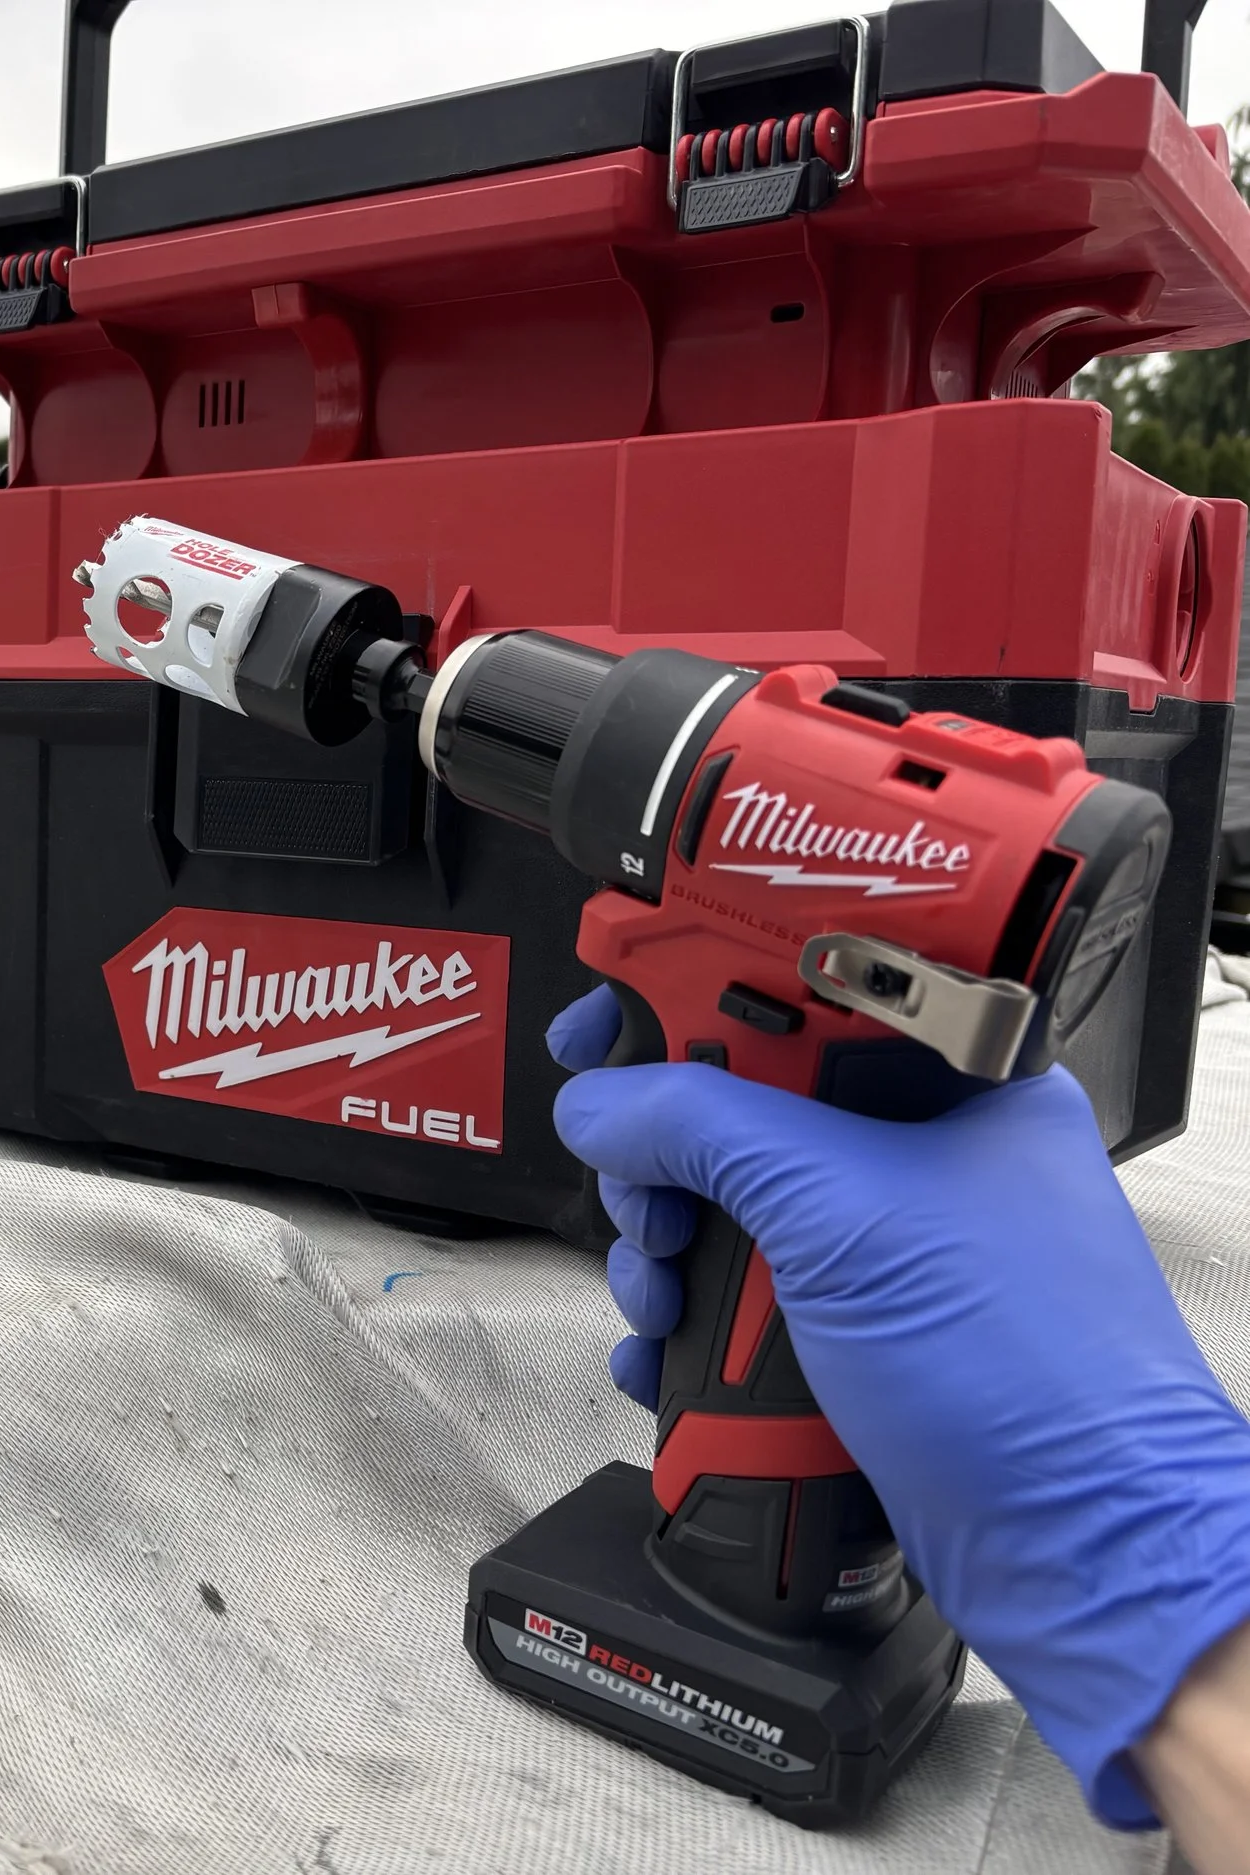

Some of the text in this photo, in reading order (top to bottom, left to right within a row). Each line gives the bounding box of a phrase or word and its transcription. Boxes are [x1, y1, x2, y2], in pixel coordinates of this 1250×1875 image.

[170, 543, 257, 575] DOZER
[184, 538, 235, 557] HOLE
[719, 781, 971, 872] Milwaukee
[620, 852, 644, 877] 12
[670, 883, 808, 947] BRUSHLESS
[132, 938, 477, 1049] Milwaukee
[341, 1095, 500, 1148] FUEL
[515, 1634, 790, 1769] HIGH OUTPUT XC5.0
[527, 1612, 785, 1746] M12 REDLITHIUM
